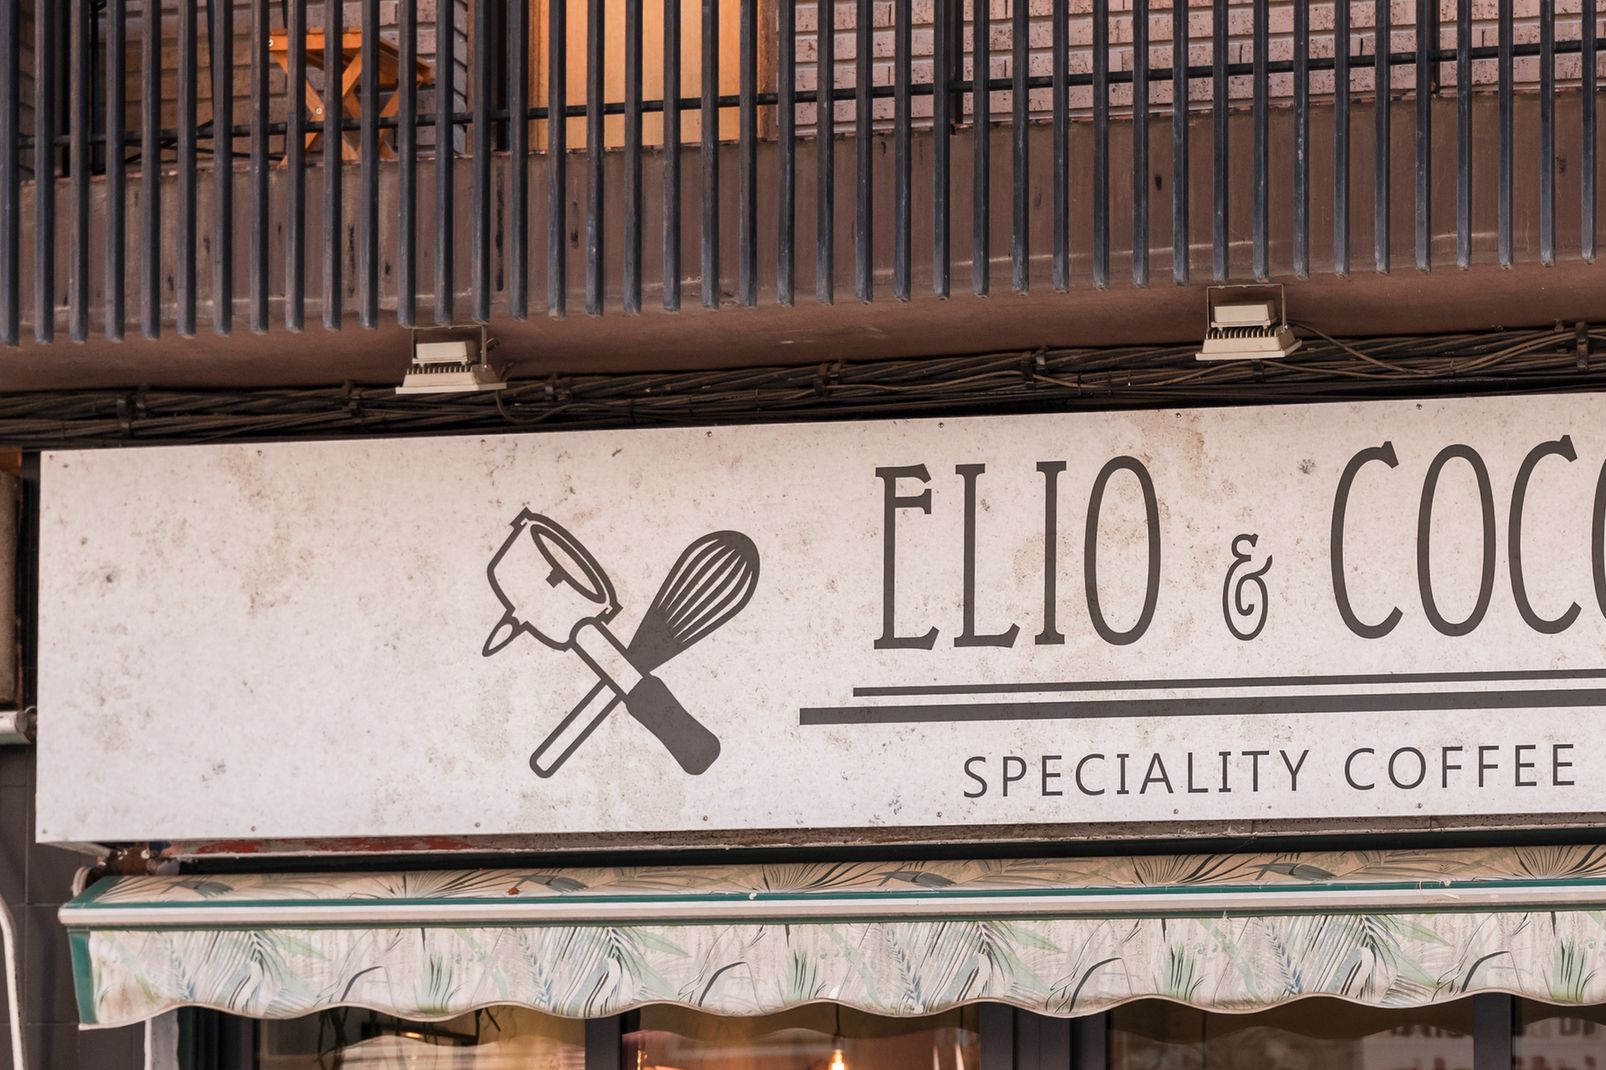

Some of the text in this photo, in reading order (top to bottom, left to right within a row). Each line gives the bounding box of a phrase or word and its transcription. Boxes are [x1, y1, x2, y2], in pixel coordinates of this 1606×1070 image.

[873, 455, 1162, 650] ELIO
[1222, 533, 1273, 641] &
[962, 742, 1576, 798] SPECIALITY COFFEE
